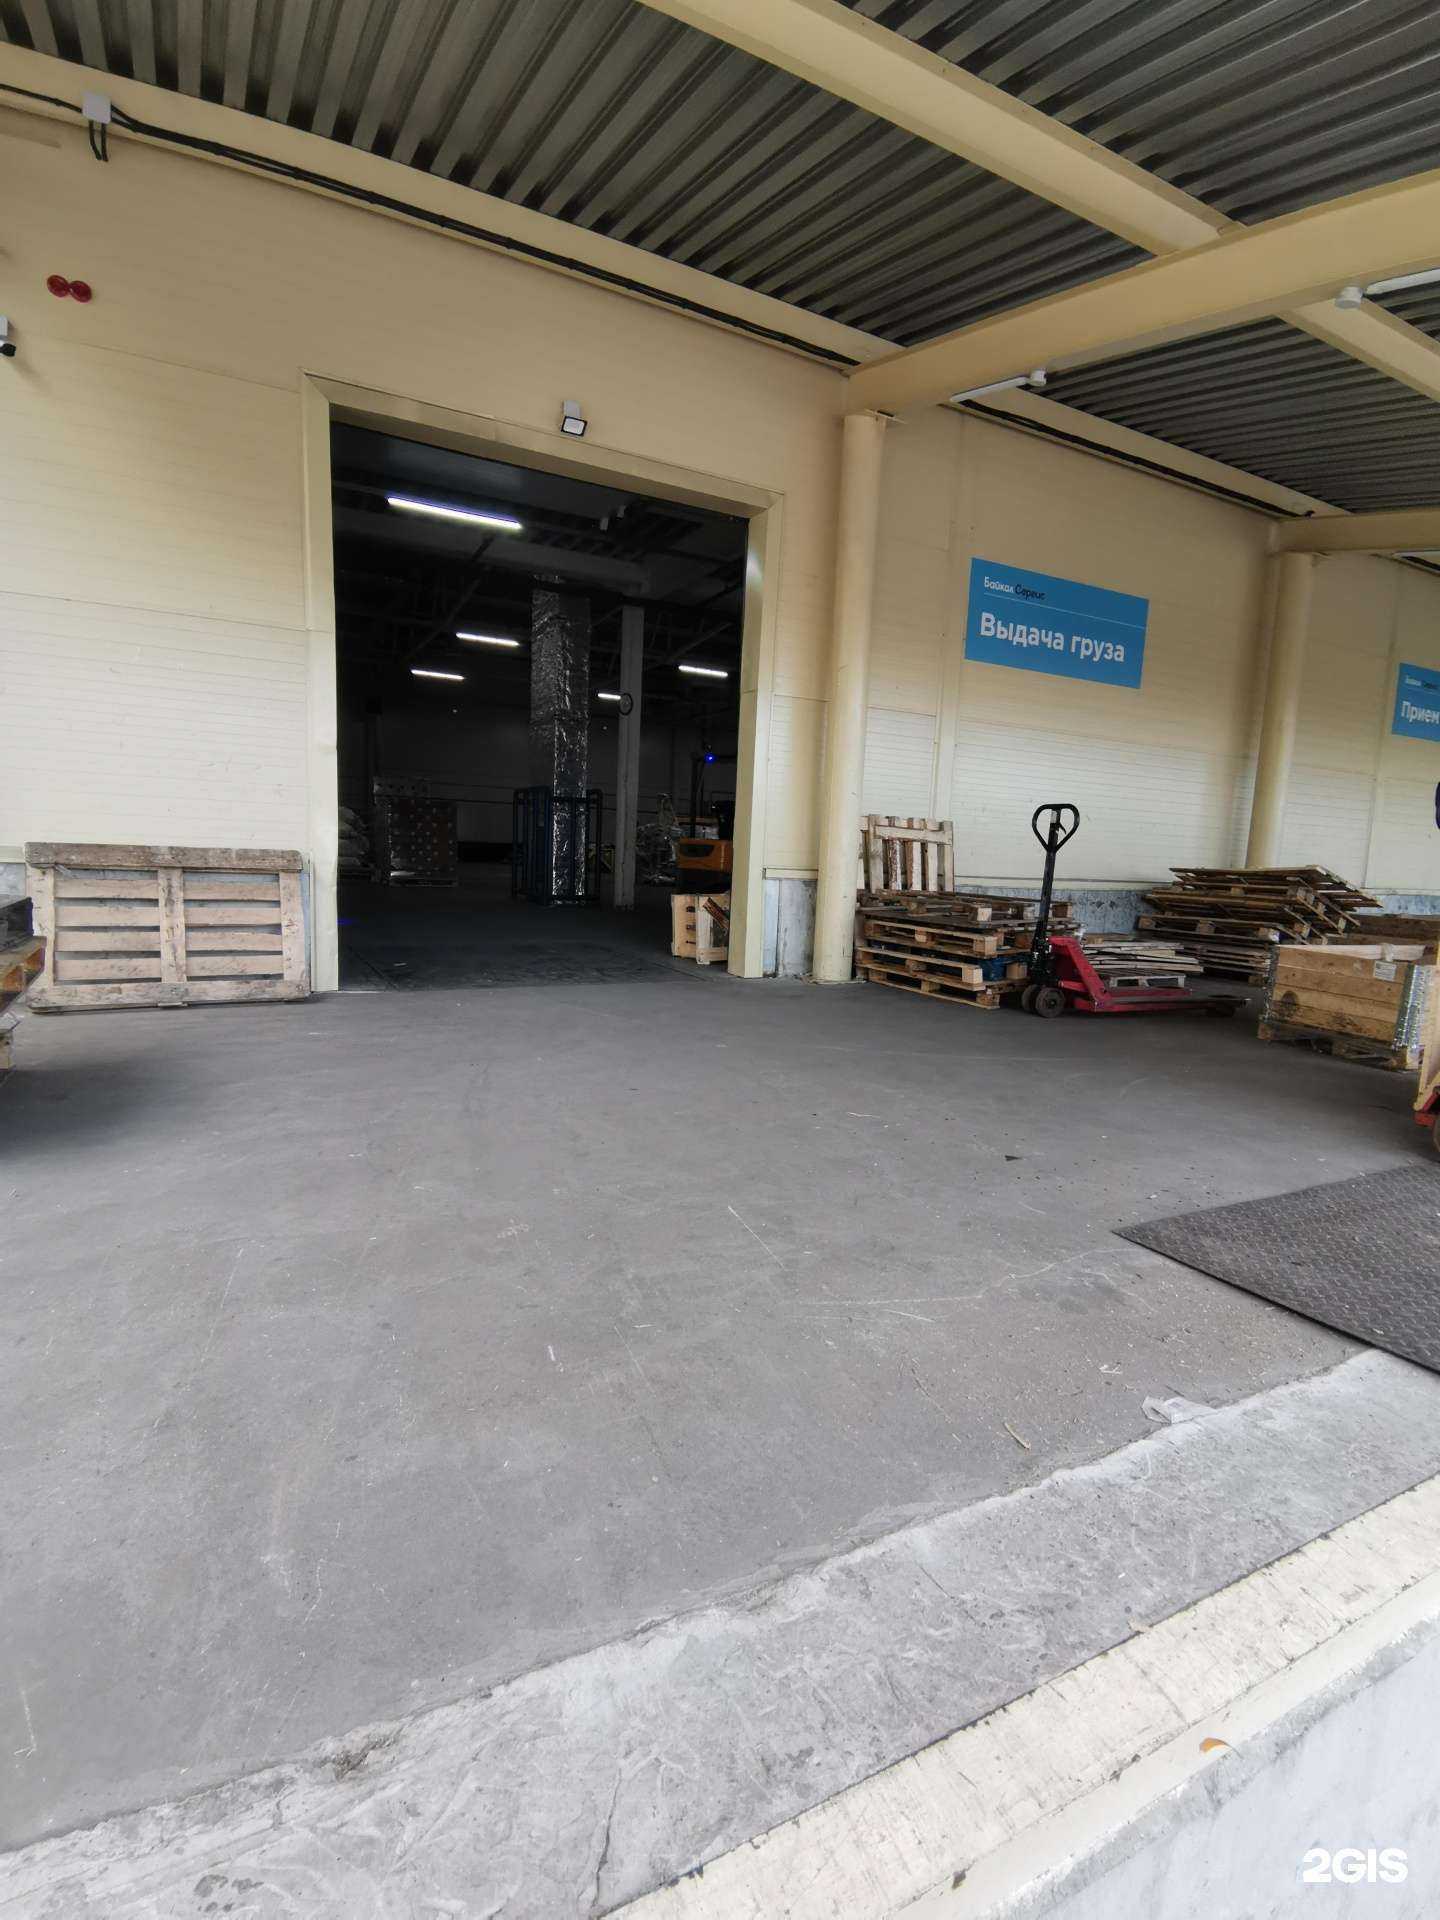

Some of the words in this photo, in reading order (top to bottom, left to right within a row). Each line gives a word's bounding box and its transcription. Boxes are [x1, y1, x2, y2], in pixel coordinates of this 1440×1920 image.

[983, 576, 1014, 593] Байкал
[980, 612, 1065, 650] Выдача
[1071, 635, 1126, 662] груза
